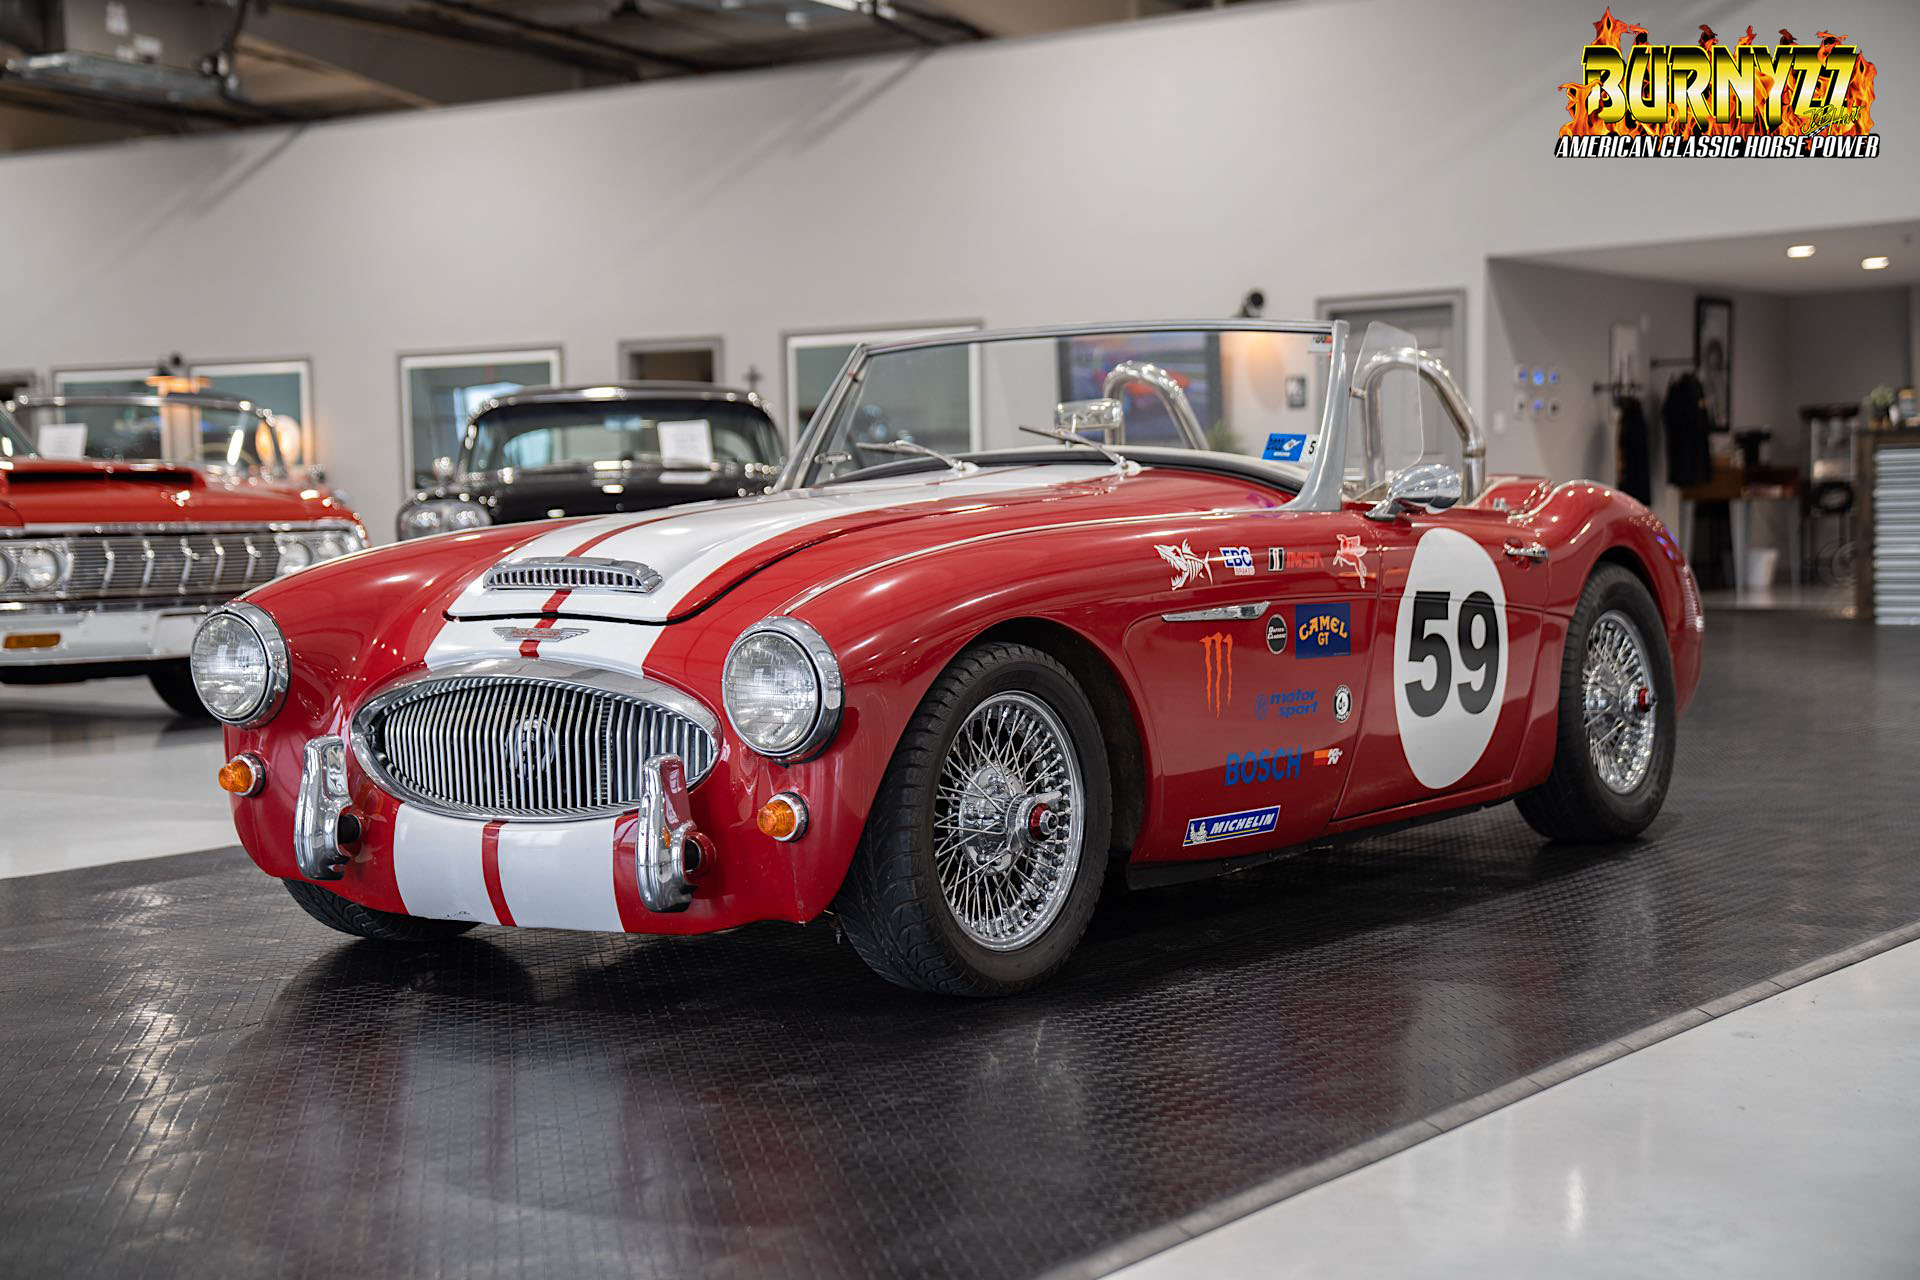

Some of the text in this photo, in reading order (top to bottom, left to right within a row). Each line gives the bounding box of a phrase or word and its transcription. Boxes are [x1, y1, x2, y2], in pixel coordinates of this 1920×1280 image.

[1309, 440, 1317, 455] 5
[1221, 549, 1253, 567] EBC
[1286, 551, 1326, 569] IMSA
[1299, 615, 1348, 641] CAMEL
[1317, 632, 1330, 647] GT
[1405, 590, 1499, 718] 59
[1270, 689, 1317, 705] motor
[1279, 702, 1319, 718] sport
[1225, 744, 1302, 785] BOSCH
[1210, 813, 1275, 835] MICHELIN
